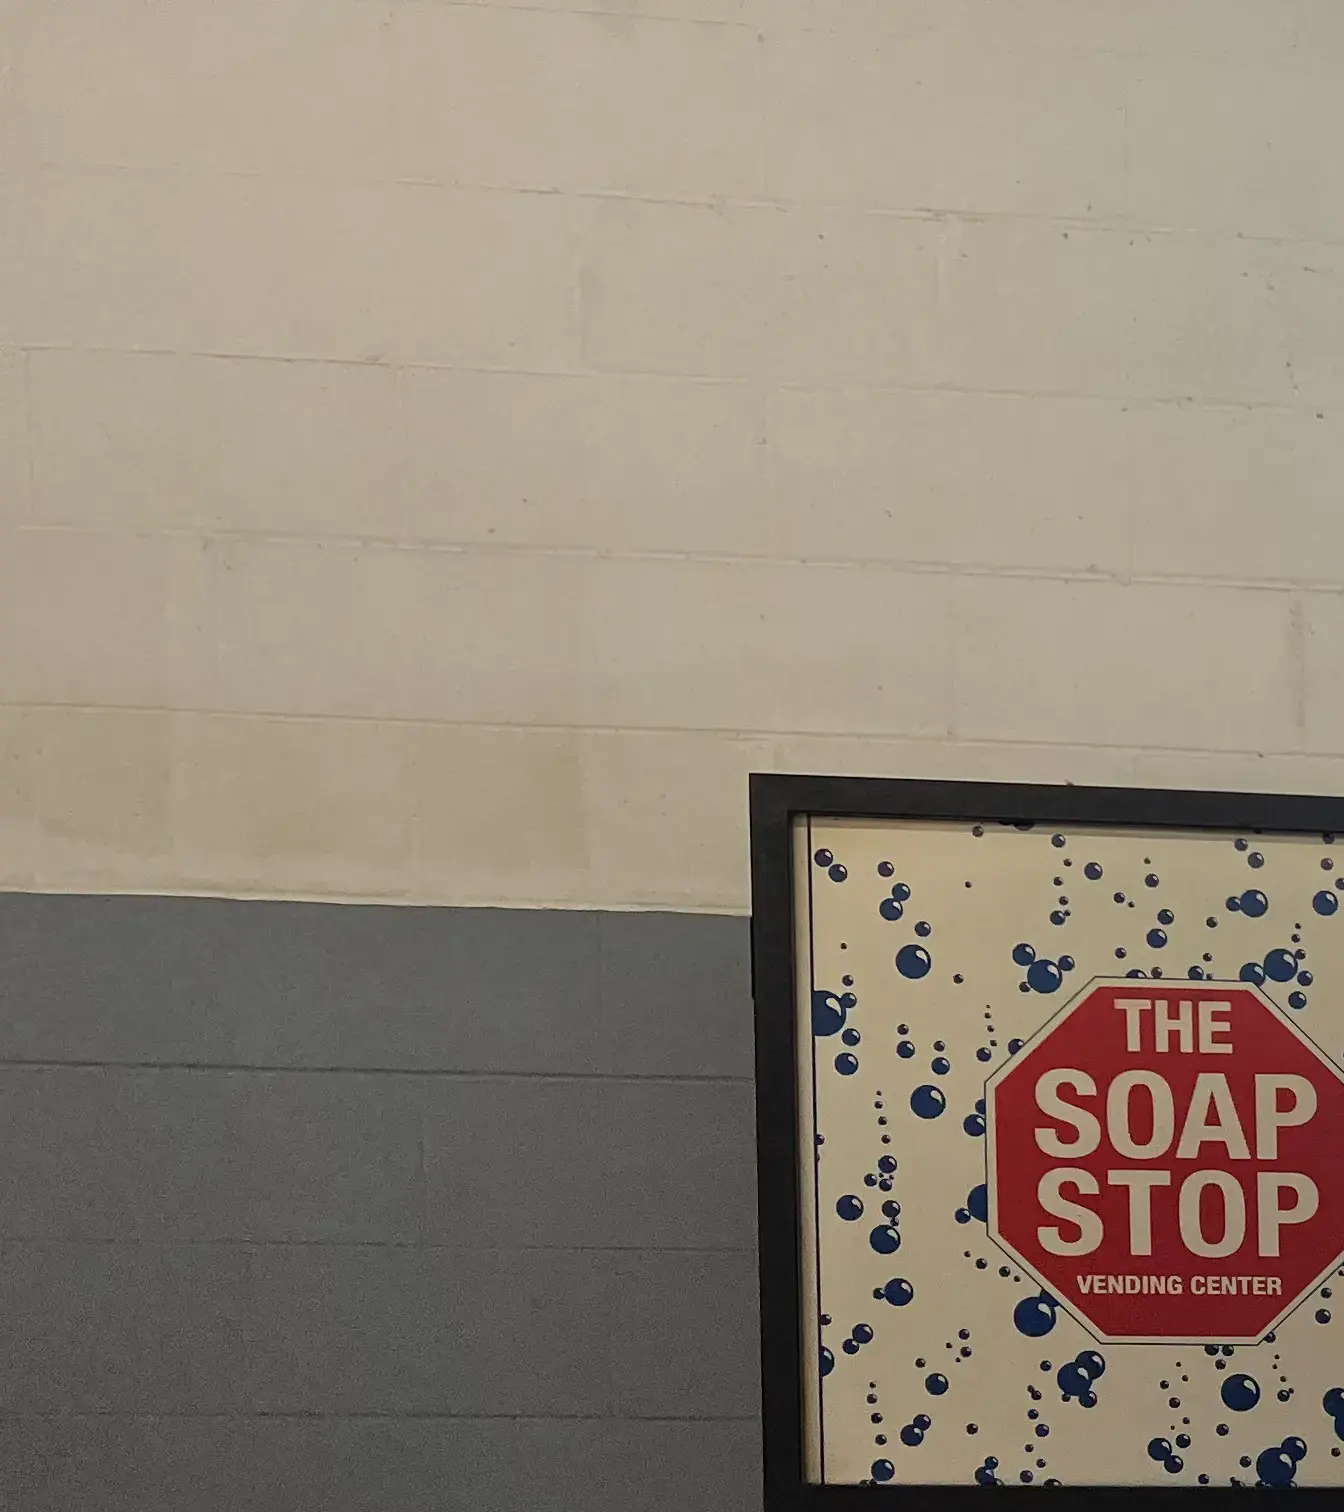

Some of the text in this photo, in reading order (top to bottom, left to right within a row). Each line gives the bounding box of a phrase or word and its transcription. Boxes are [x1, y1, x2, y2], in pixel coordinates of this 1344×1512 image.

[1113, 998, 1233, 1054] THE
[1034, 1067, 1318, 1160] SOAP
[1036, 1166, 1320, 1259] STOP
[1076, 1275, 1282, 1296] VENDING CENTER
